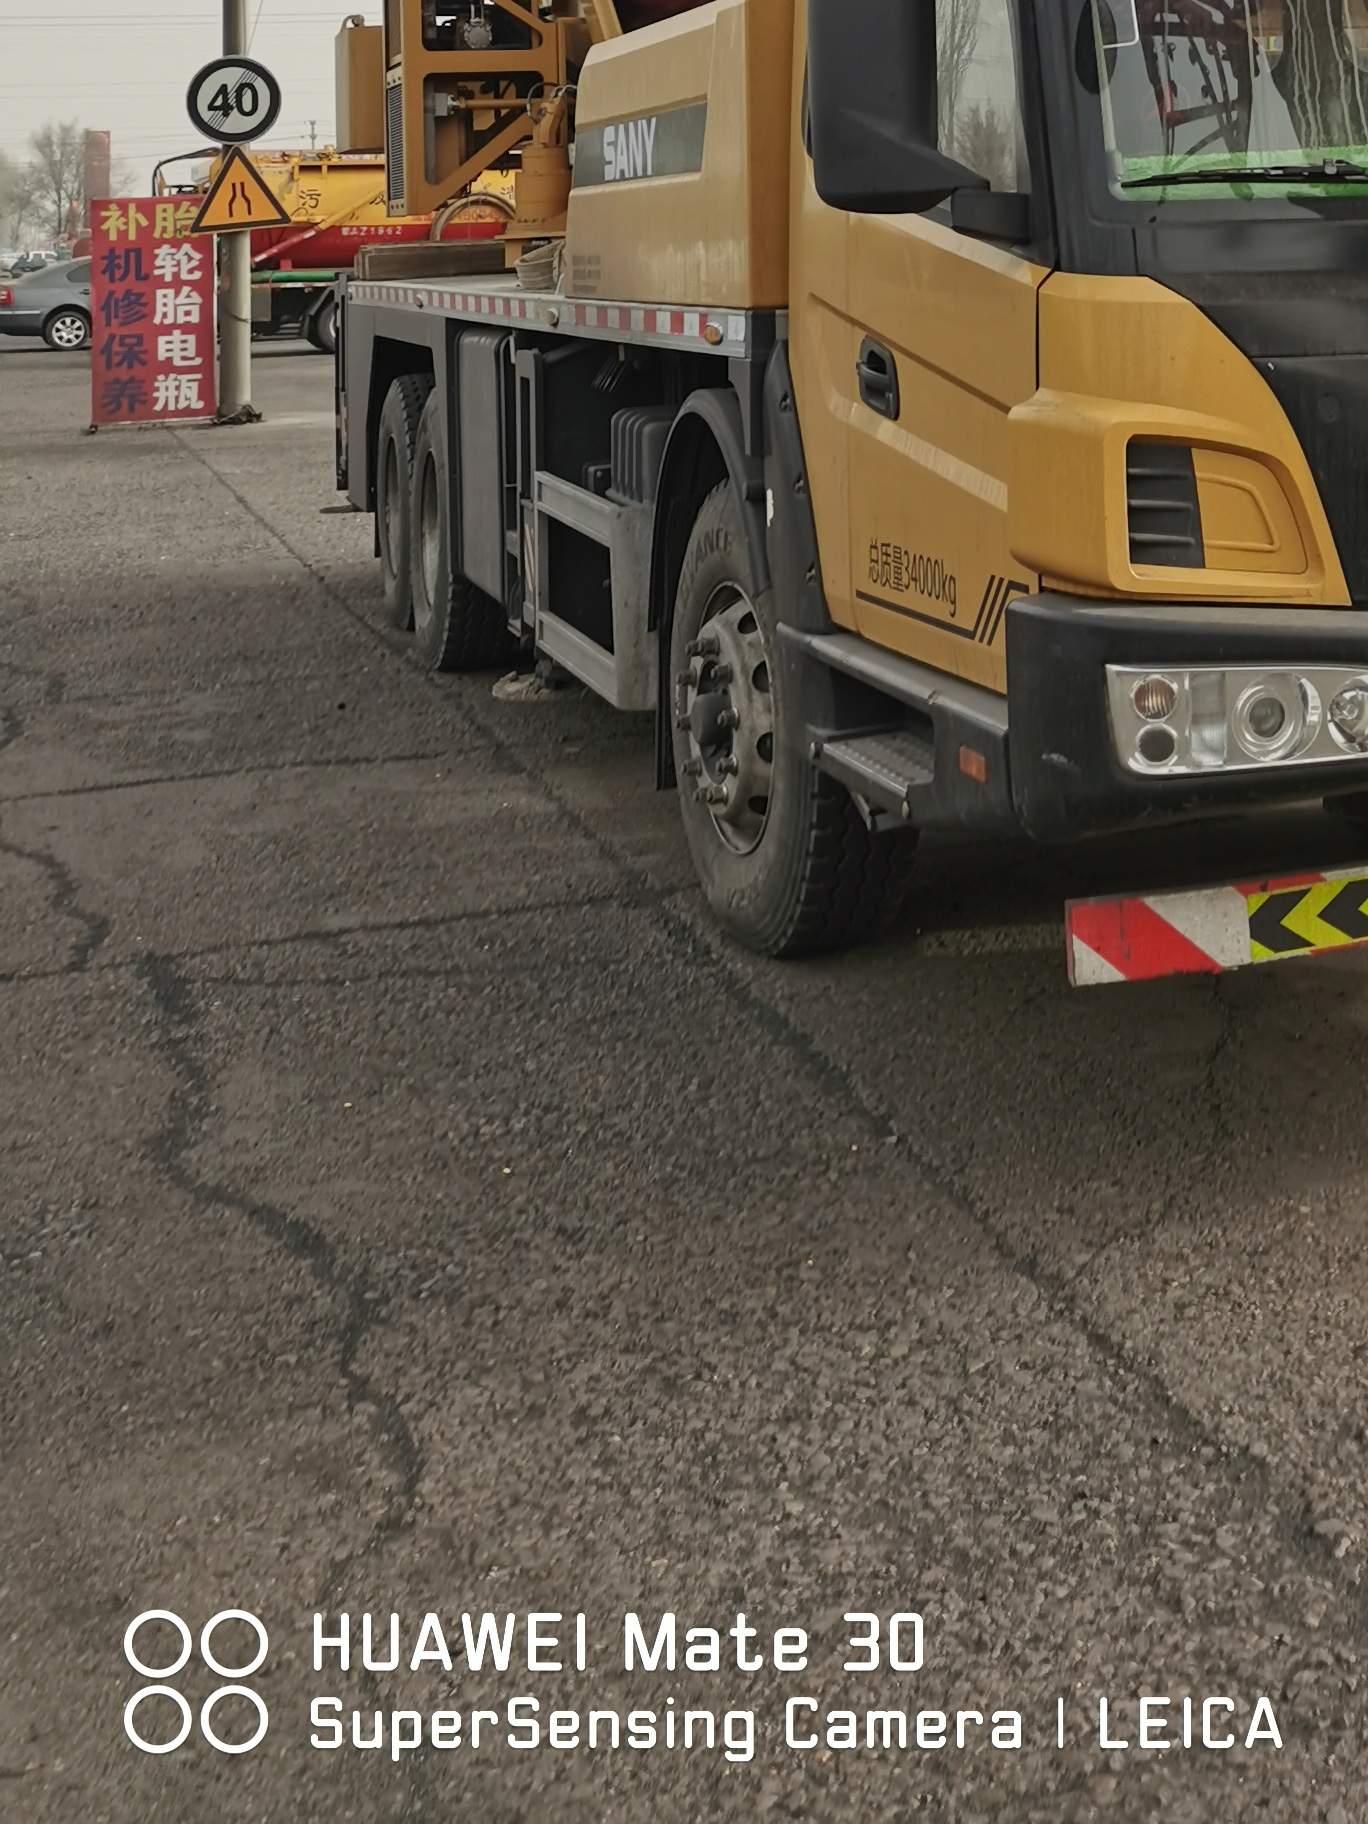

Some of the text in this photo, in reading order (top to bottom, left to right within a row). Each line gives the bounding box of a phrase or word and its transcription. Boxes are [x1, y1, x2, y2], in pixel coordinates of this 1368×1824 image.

[207, 83, 259, 118] 40
[603, 116, 656, 181] SANY
[100, 201, 200, 241] 补胎
[100, 246, 149, 415] 机修保养
[152, 242, 205, 412] 轮胎电瓶
[868, 538, 957, 618] 总质量34000kg
